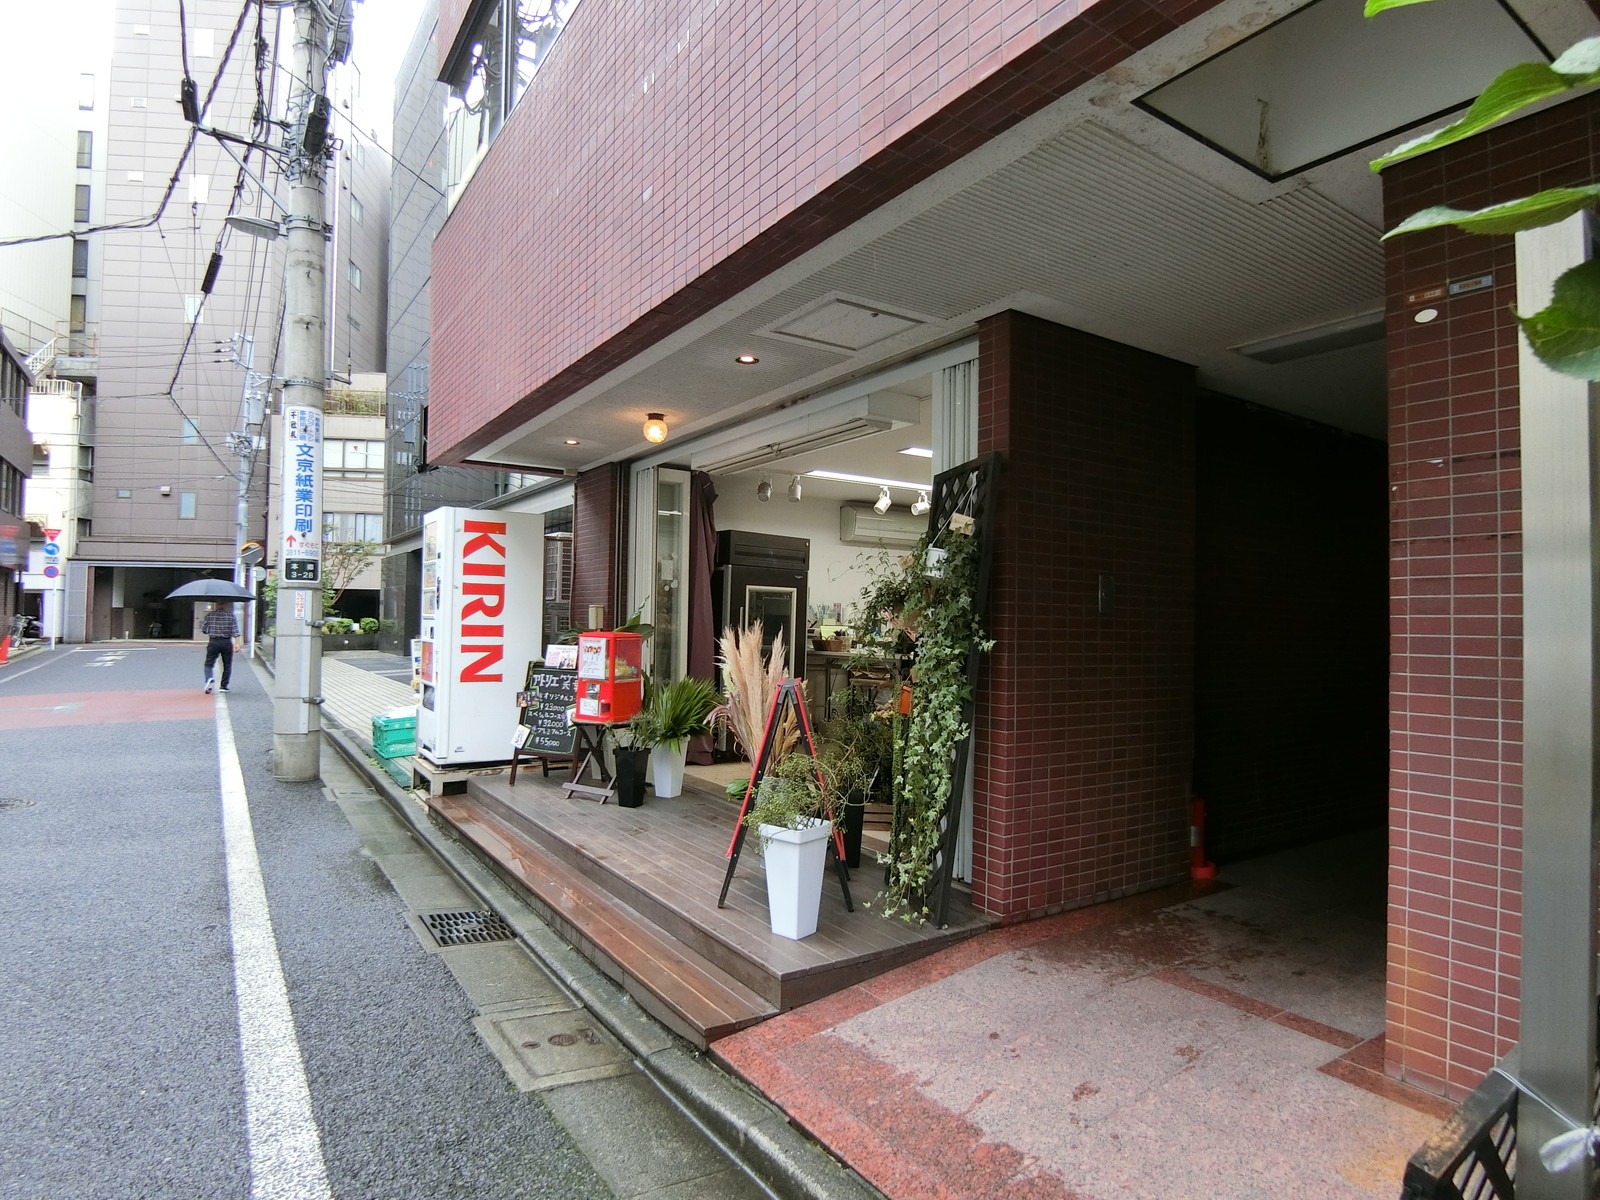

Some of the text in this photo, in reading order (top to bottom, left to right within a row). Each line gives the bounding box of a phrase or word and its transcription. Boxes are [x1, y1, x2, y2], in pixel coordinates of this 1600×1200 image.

[295, 443, 315, 533] 文京紙業印刷
[291, 571, 314, 579] 3-28
[460, 519, 507, 683] KIRIN
